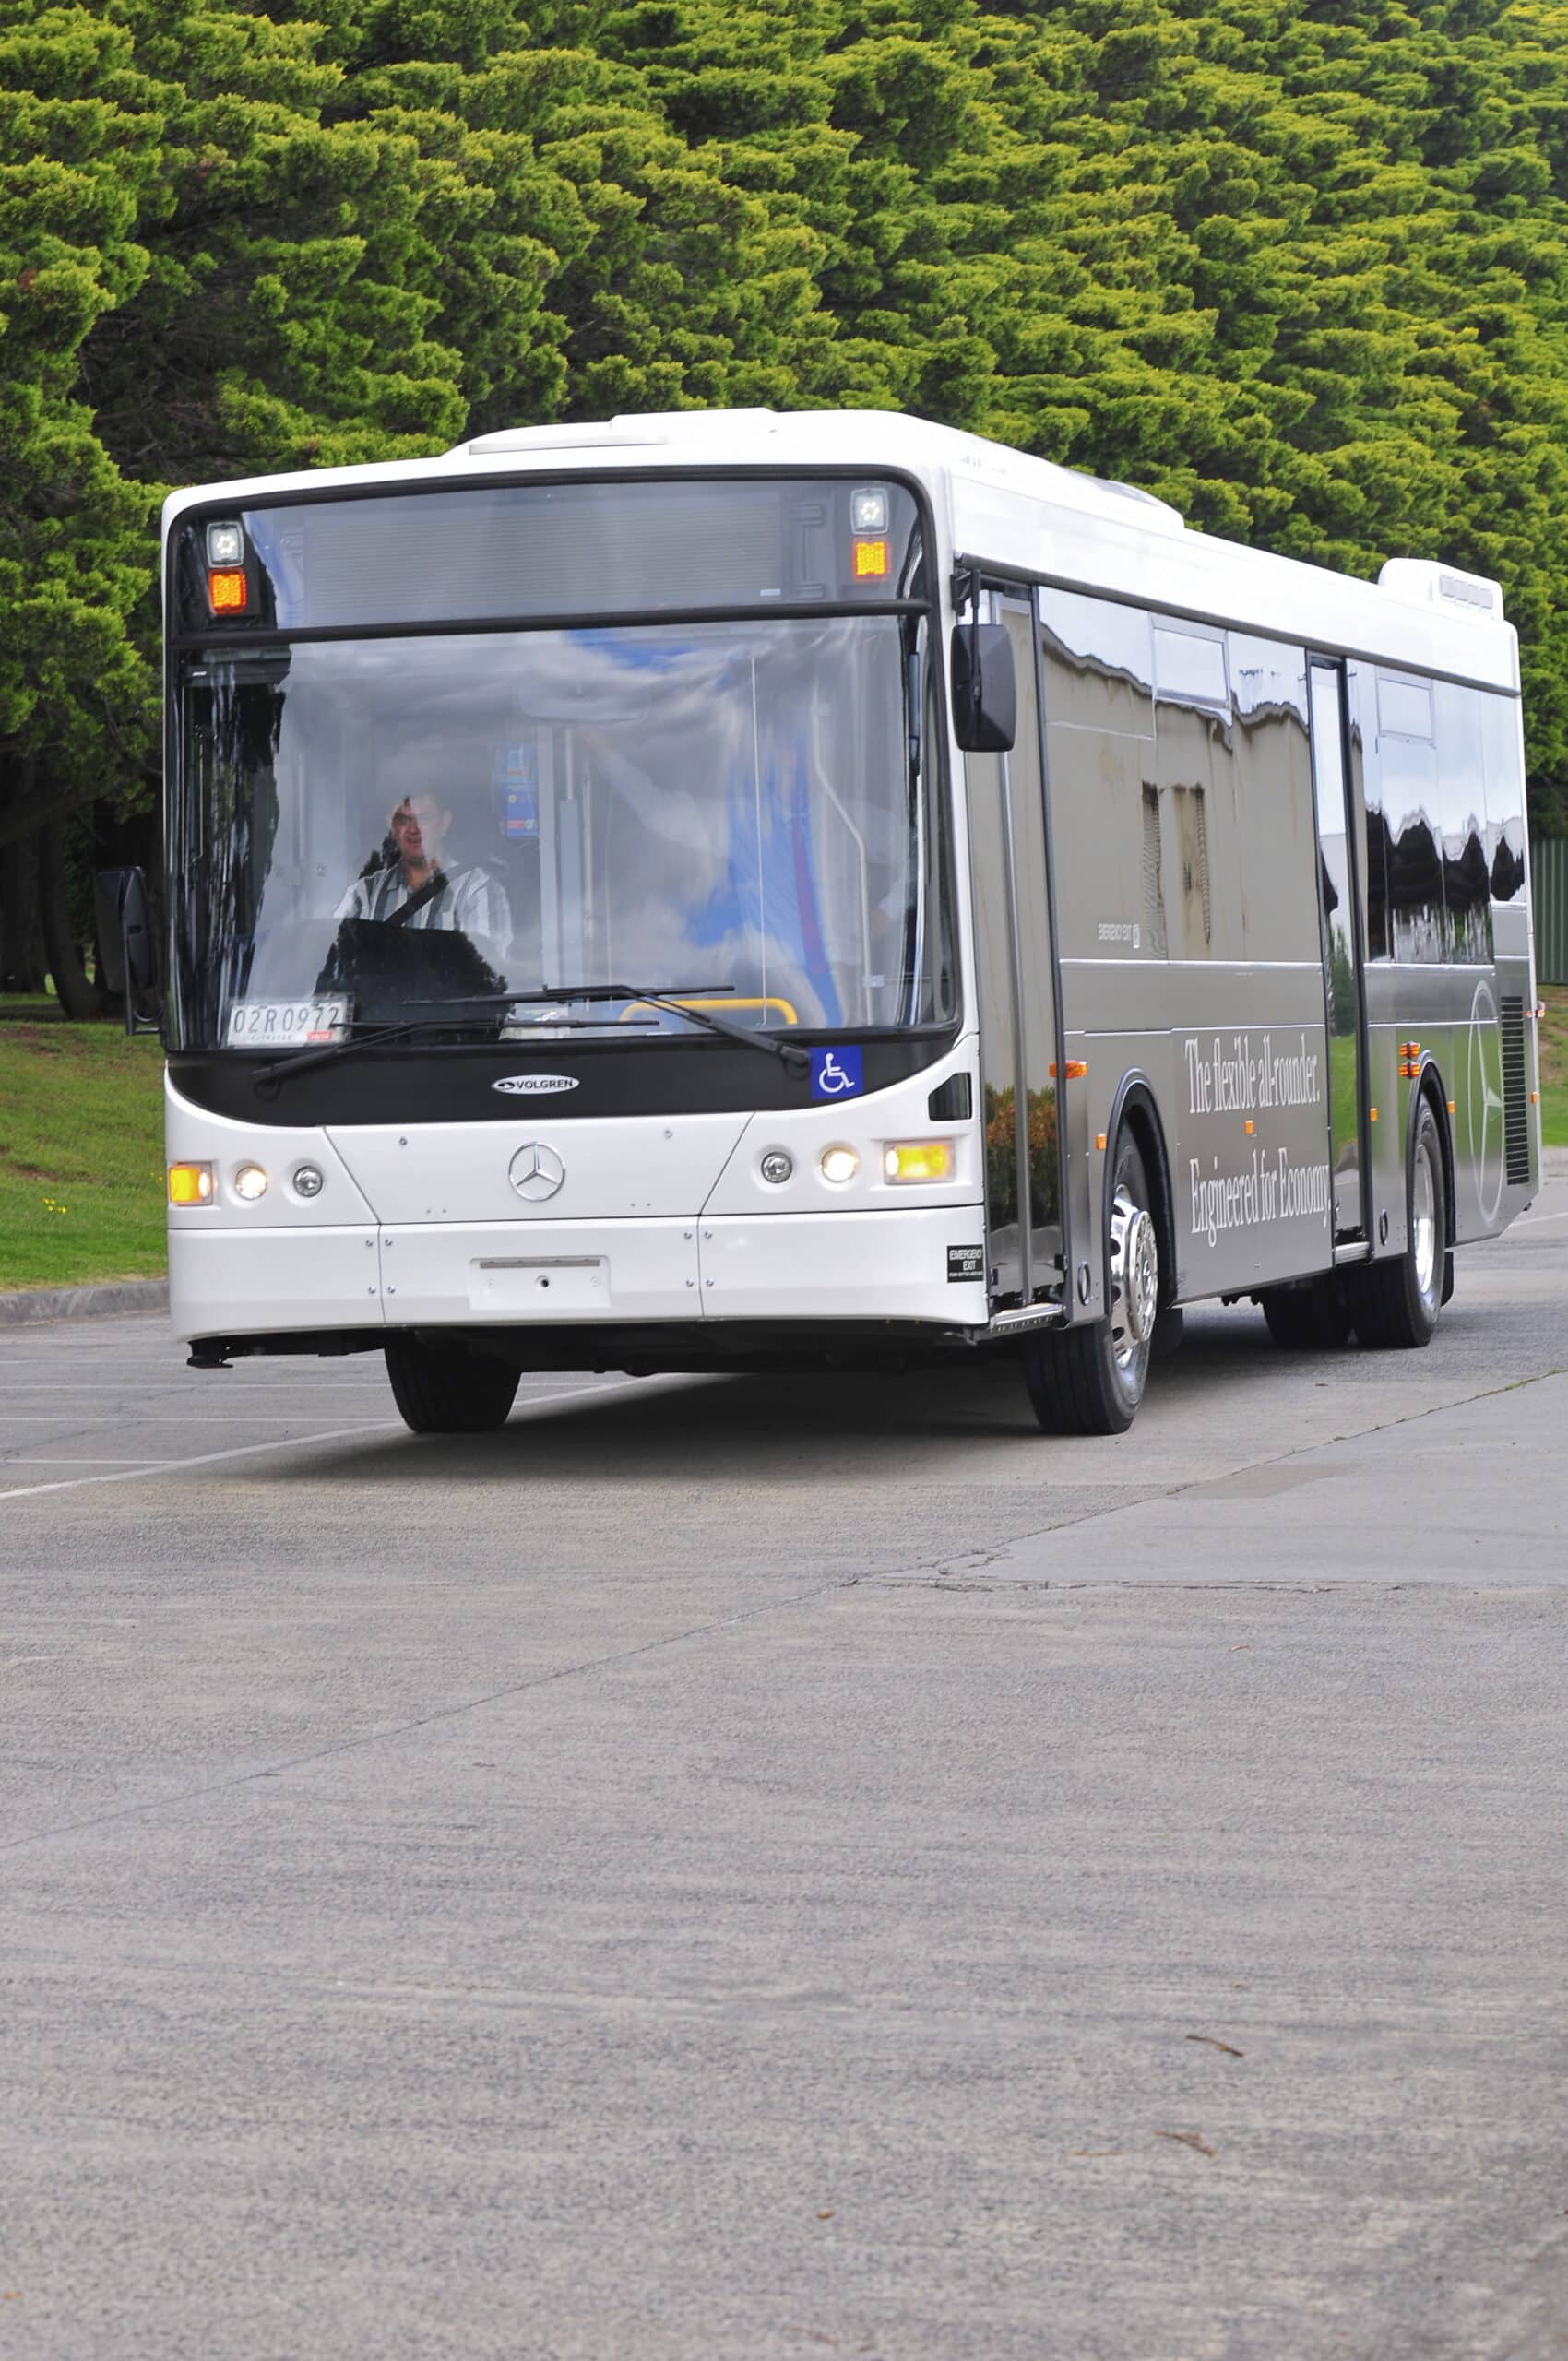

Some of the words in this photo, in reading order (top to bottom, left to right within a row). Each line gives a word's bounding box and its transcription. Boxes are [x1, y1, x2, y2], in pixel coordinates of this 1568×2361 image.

[517, 1079, 573, 1089] VOLGREN
[1185, 1035, 1211, 1114] The
[1213, 1034, 1256, 1111] flexible
[1258, 1033, 1320, 1108] all-rounder.
[1189, 1148, 1259, 1248] Engineered
[1260, 1148, 1277, 1222] for
[1278, 1147, 1331, 1228] Economy.
